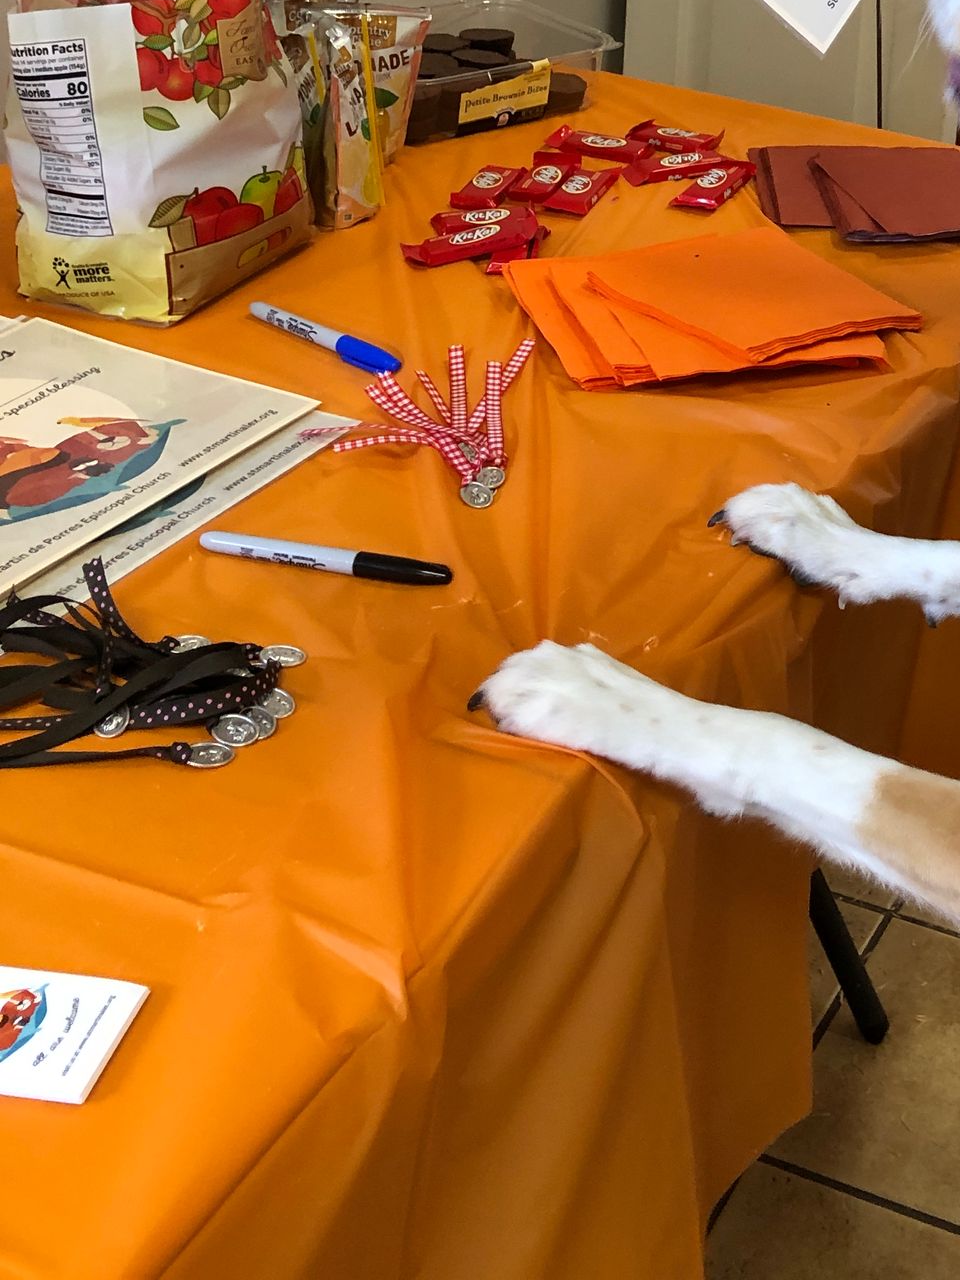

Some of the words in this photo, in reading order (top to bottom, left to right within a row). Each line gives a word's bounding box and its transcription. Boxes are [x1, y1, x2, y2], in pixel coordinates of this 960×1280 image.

[351, 24, 392, 40] ountry
[11, 46, 49, 58] utrition
[52, 42, 84, 55] Facts
[16, 87, 51, 98] Calories
[67, 81, 88, 96] 80
[464, 96, 491, 113] Petite
[492, 89, 526, 103] Brownie
[526, 85, 548, 95] Bites
[73, 266, 110, 277] more
[3, 391, 50, 416] special
[46, 366, 101, 394] blessing
[0, 553, 30, 573] artin
[28, 540, 45, 554] de
[43, 523, 84, 545] Porres
[82, 493, 134, 524] Episcopal
[132, 471, 172, 494] Church
[178, 408, 278, 468] www.stmartinalex.org
[128, 515, 181, 552] Episcopal
[177, 496, 217, 521] Church
